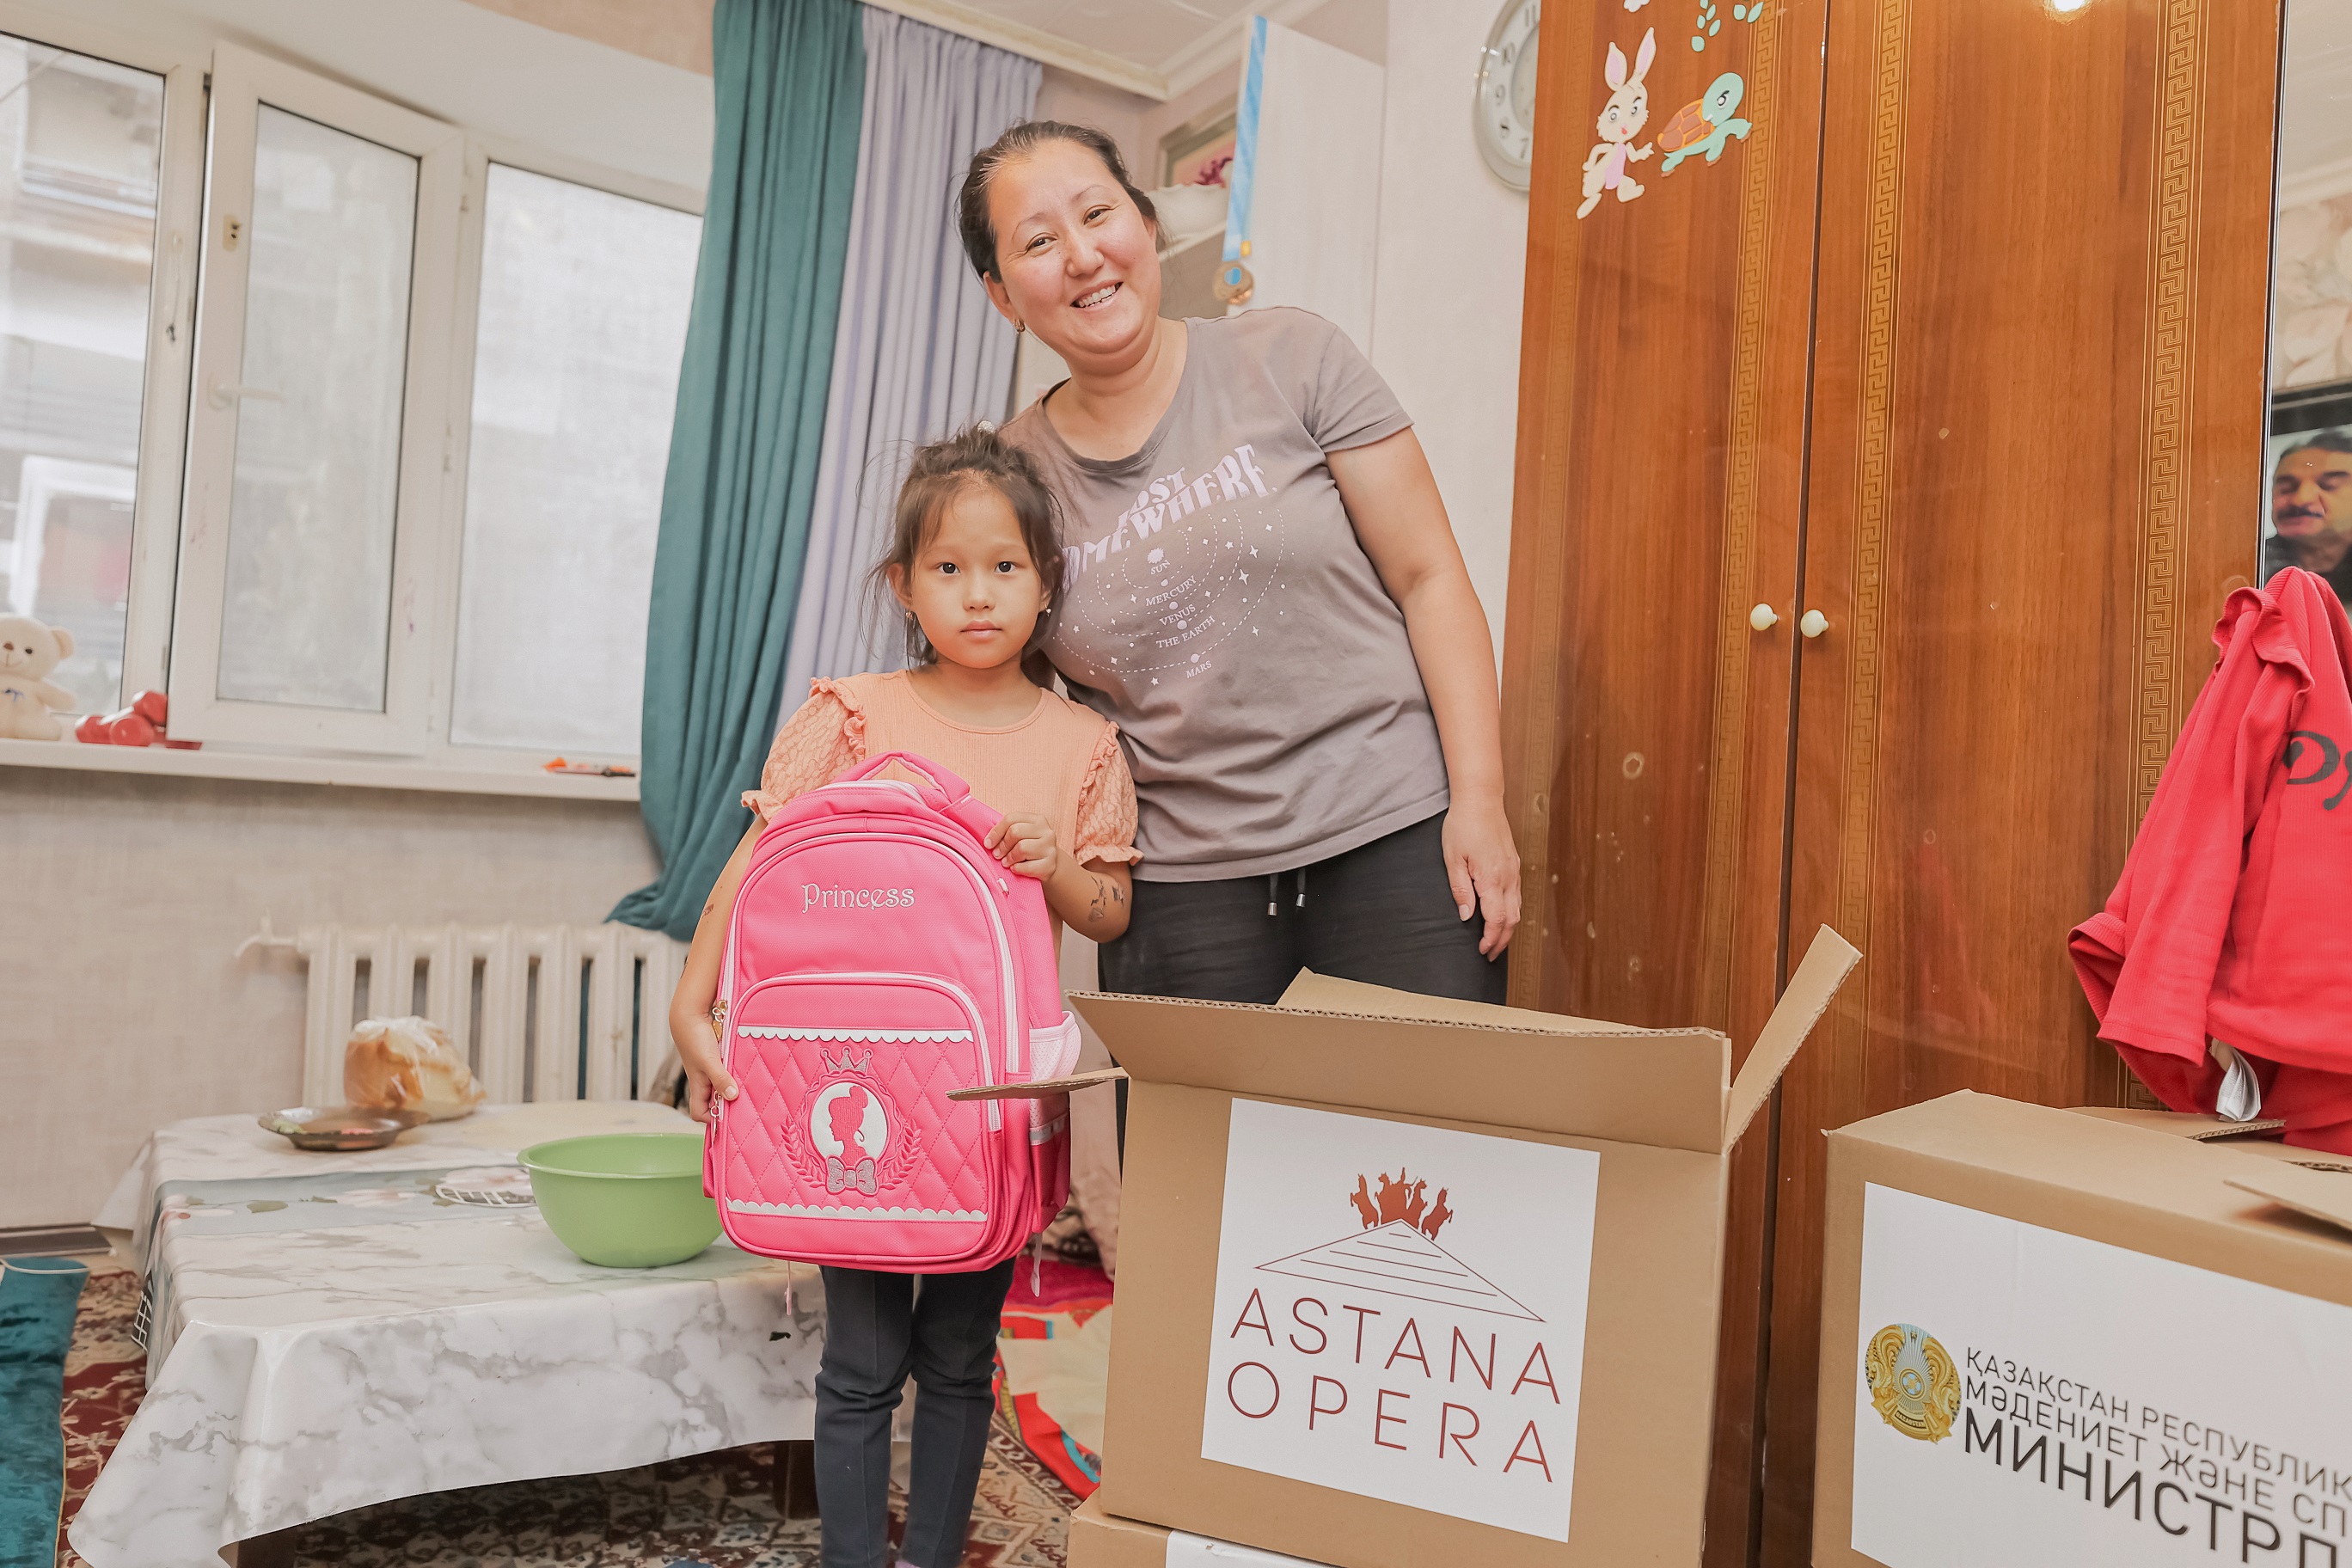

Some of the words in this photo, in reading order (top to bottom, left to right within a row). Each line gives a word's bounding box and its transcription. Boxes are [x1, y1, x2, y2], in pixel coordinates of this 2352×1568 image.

[1062, 443, 1278, 595] OMEWHERE
[1150, 559, 1170, 575] SUN
[1145, 575, 1197, 607] MERCURY
[1159, 603, 1196, 626] VENUS
[1155, 636, 1180, 648] THE
[1181, 615, 1216, 642] EARTH
[1185, 660, 1212, 678] MARS
[800, 882, 916, 914] Princess
[1229, 1287, 1561, 1405] ASTANA
[1227, 1361, 1553, 1484] OPERA
[1966, 1346, 2128, 1424] ҚАЗАҚСТАН
[2141, 1406, 2352, 1503] РЕСПУБЛИК
[1965, 1375, 2148, 1462] МӘДЕНИЕТ
[2159, 1442, 2275, 1513] ЖӘНЕ
[2293, 1492, 2346, 1538] СП
